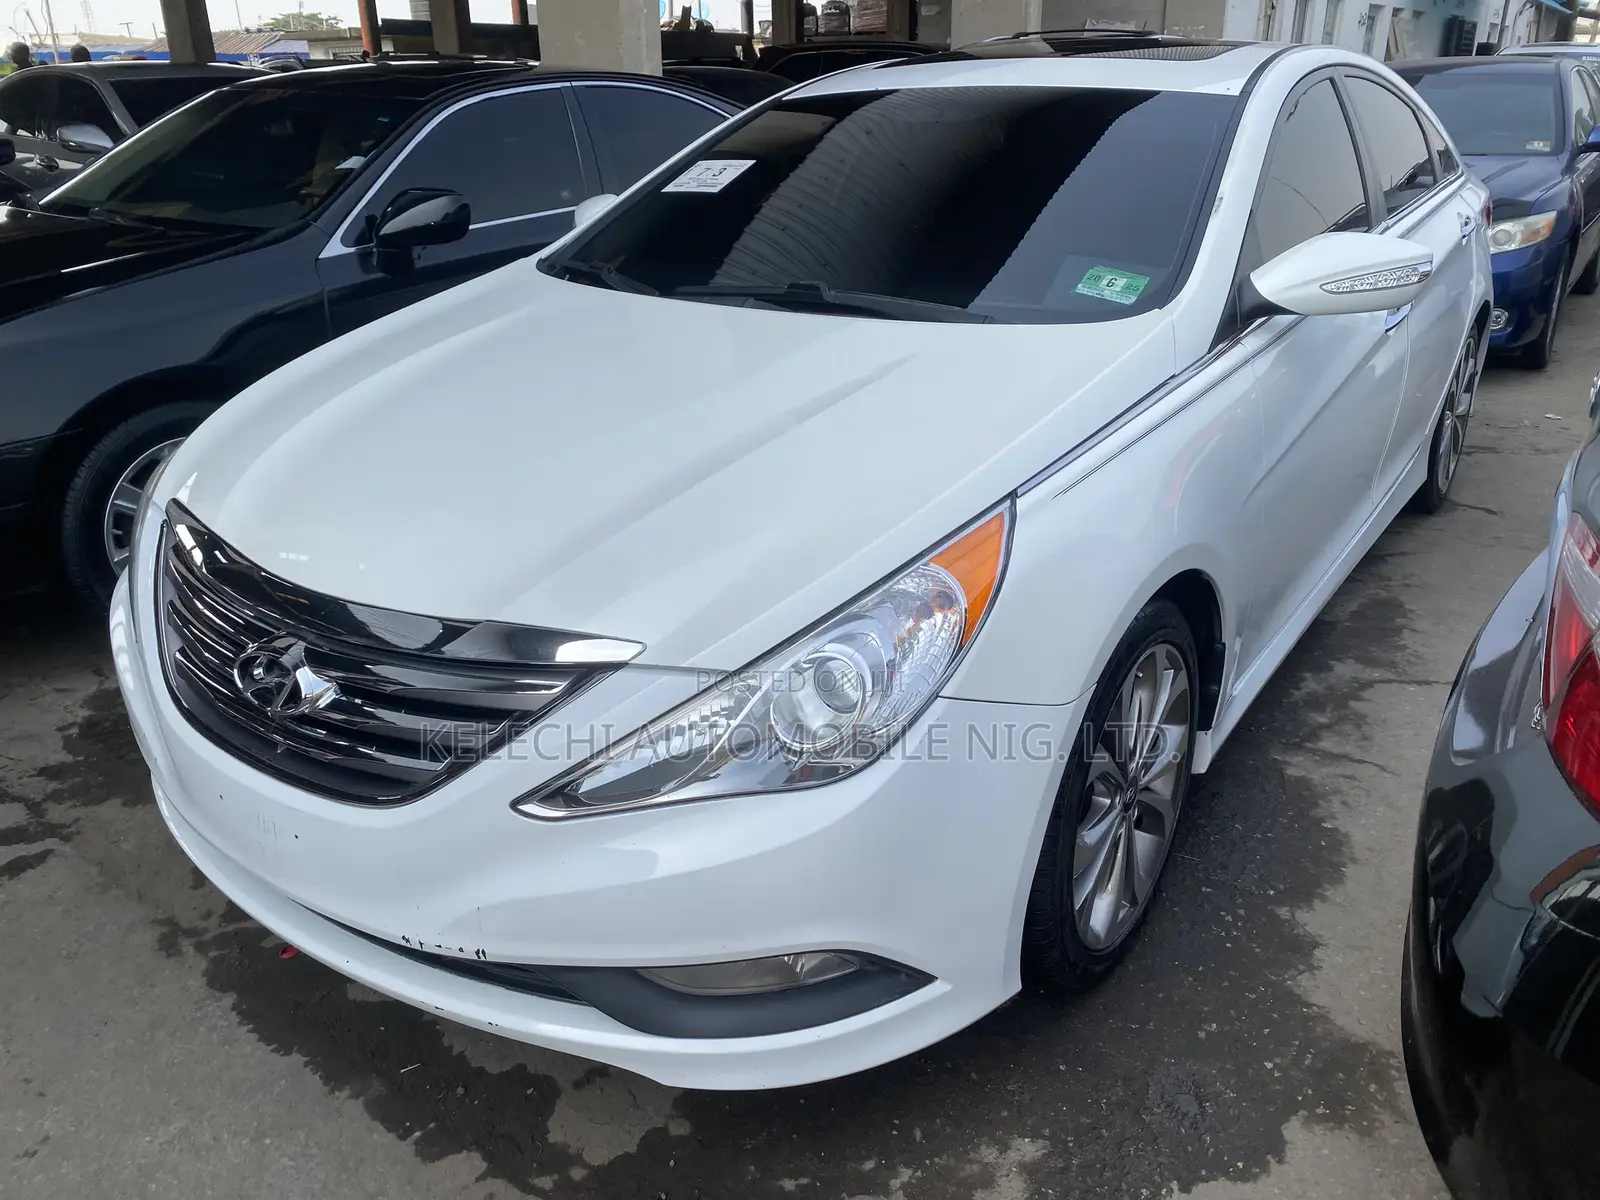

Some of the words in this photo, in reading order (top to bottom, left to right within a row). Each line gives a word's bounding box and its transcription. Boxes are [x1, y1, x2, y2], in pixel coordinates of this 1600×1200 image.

[1086, 273, 1102, 283] 20
[1106, 277, 1118, 288] 6
[1125, 283, 1141, 292] 25
